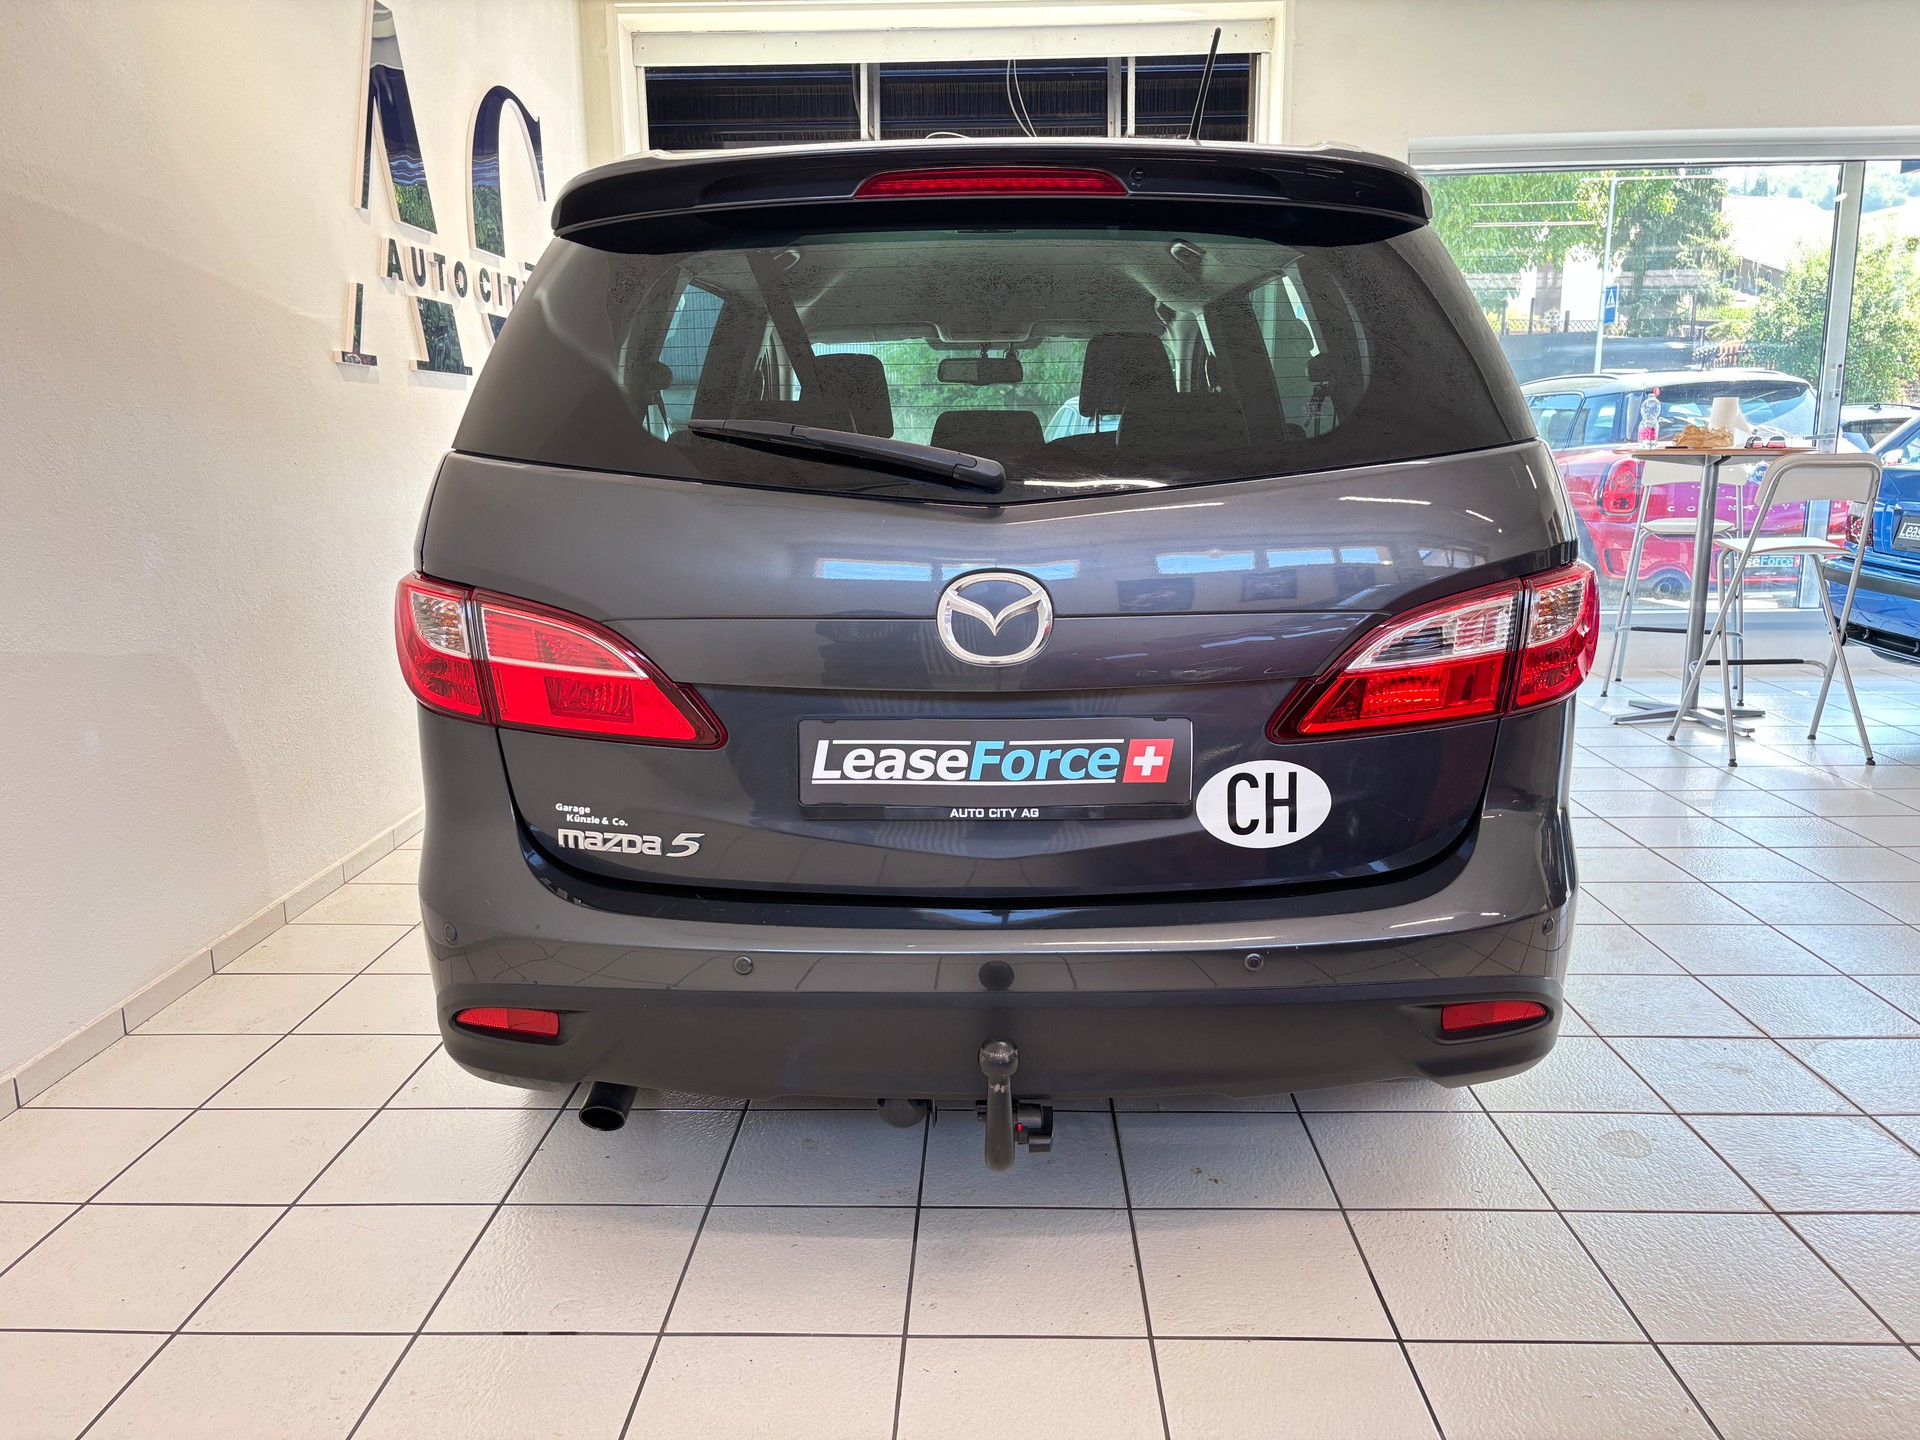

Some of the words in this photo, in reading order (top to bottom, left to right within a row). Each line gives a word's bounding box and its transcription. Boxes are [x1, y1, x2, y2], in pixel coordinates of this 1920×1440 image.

[383, 238, 468, 298] AUTO
[478, 267, 527, 309] CIT
[812, 739, 1121, 781] LeaseForce
[555, 803, 591, 814] Garage
[950, 808, 985, 818] AUTO
[988, 808, 1018, 818] CITY
[1021, 808, 1039, 818] AG
[1226, 771, 1297, 836] CH
[566, 813, 600, 825] Künzle
[601, 817, 609, 825] &
[612, 817, 629, 827] Co.
[557, 828, 663, 856] mazda
[665, 832, 706, 858] 5
